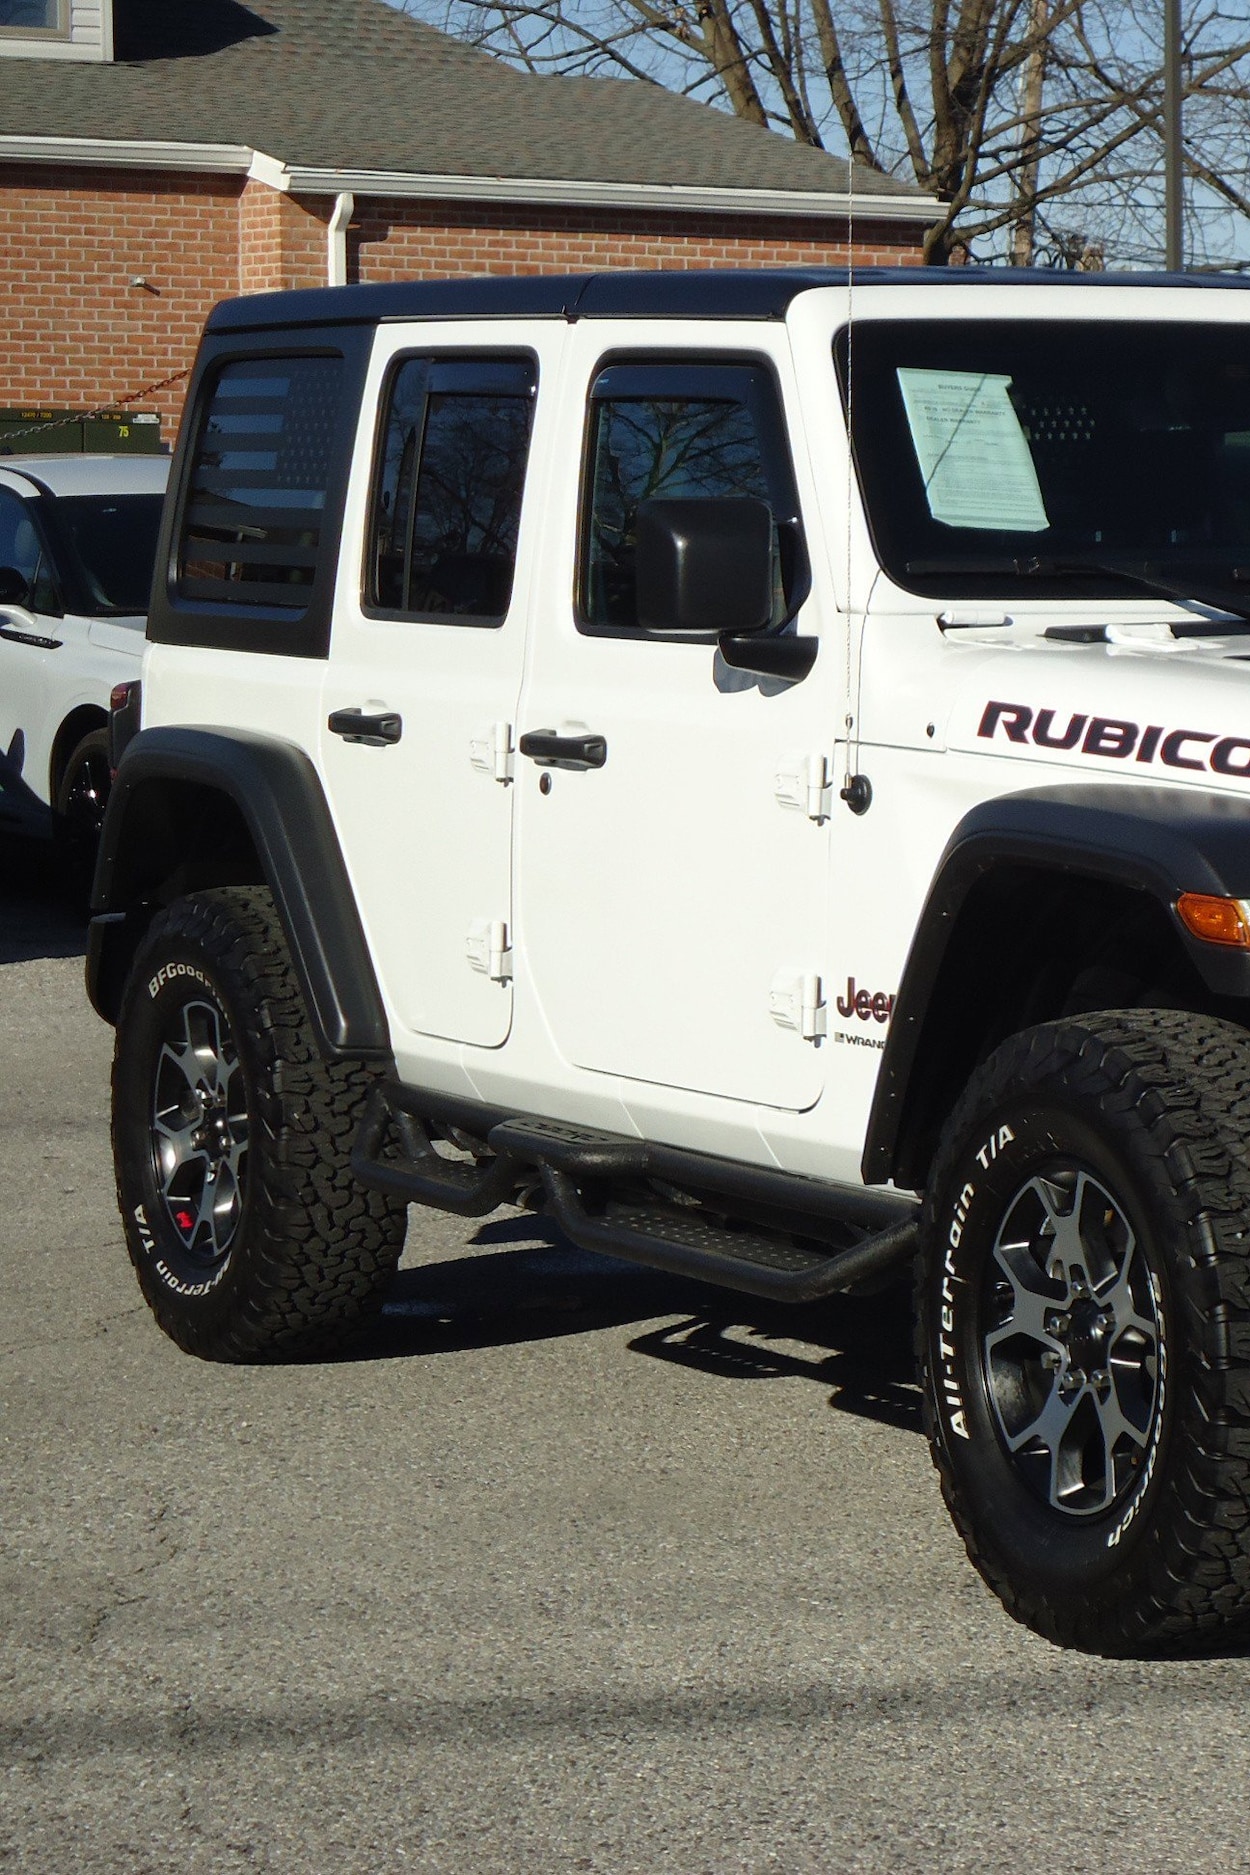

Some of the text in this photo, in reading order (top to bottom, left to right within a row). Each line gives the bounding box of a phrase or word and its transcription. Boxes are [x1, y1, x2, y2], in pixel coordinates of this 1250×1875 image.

[119, 425, 129, 437] 75
[133, 1204, 156, 1255] T/A
[938, 1123, 1016, 1440] All-Terrain T/A
